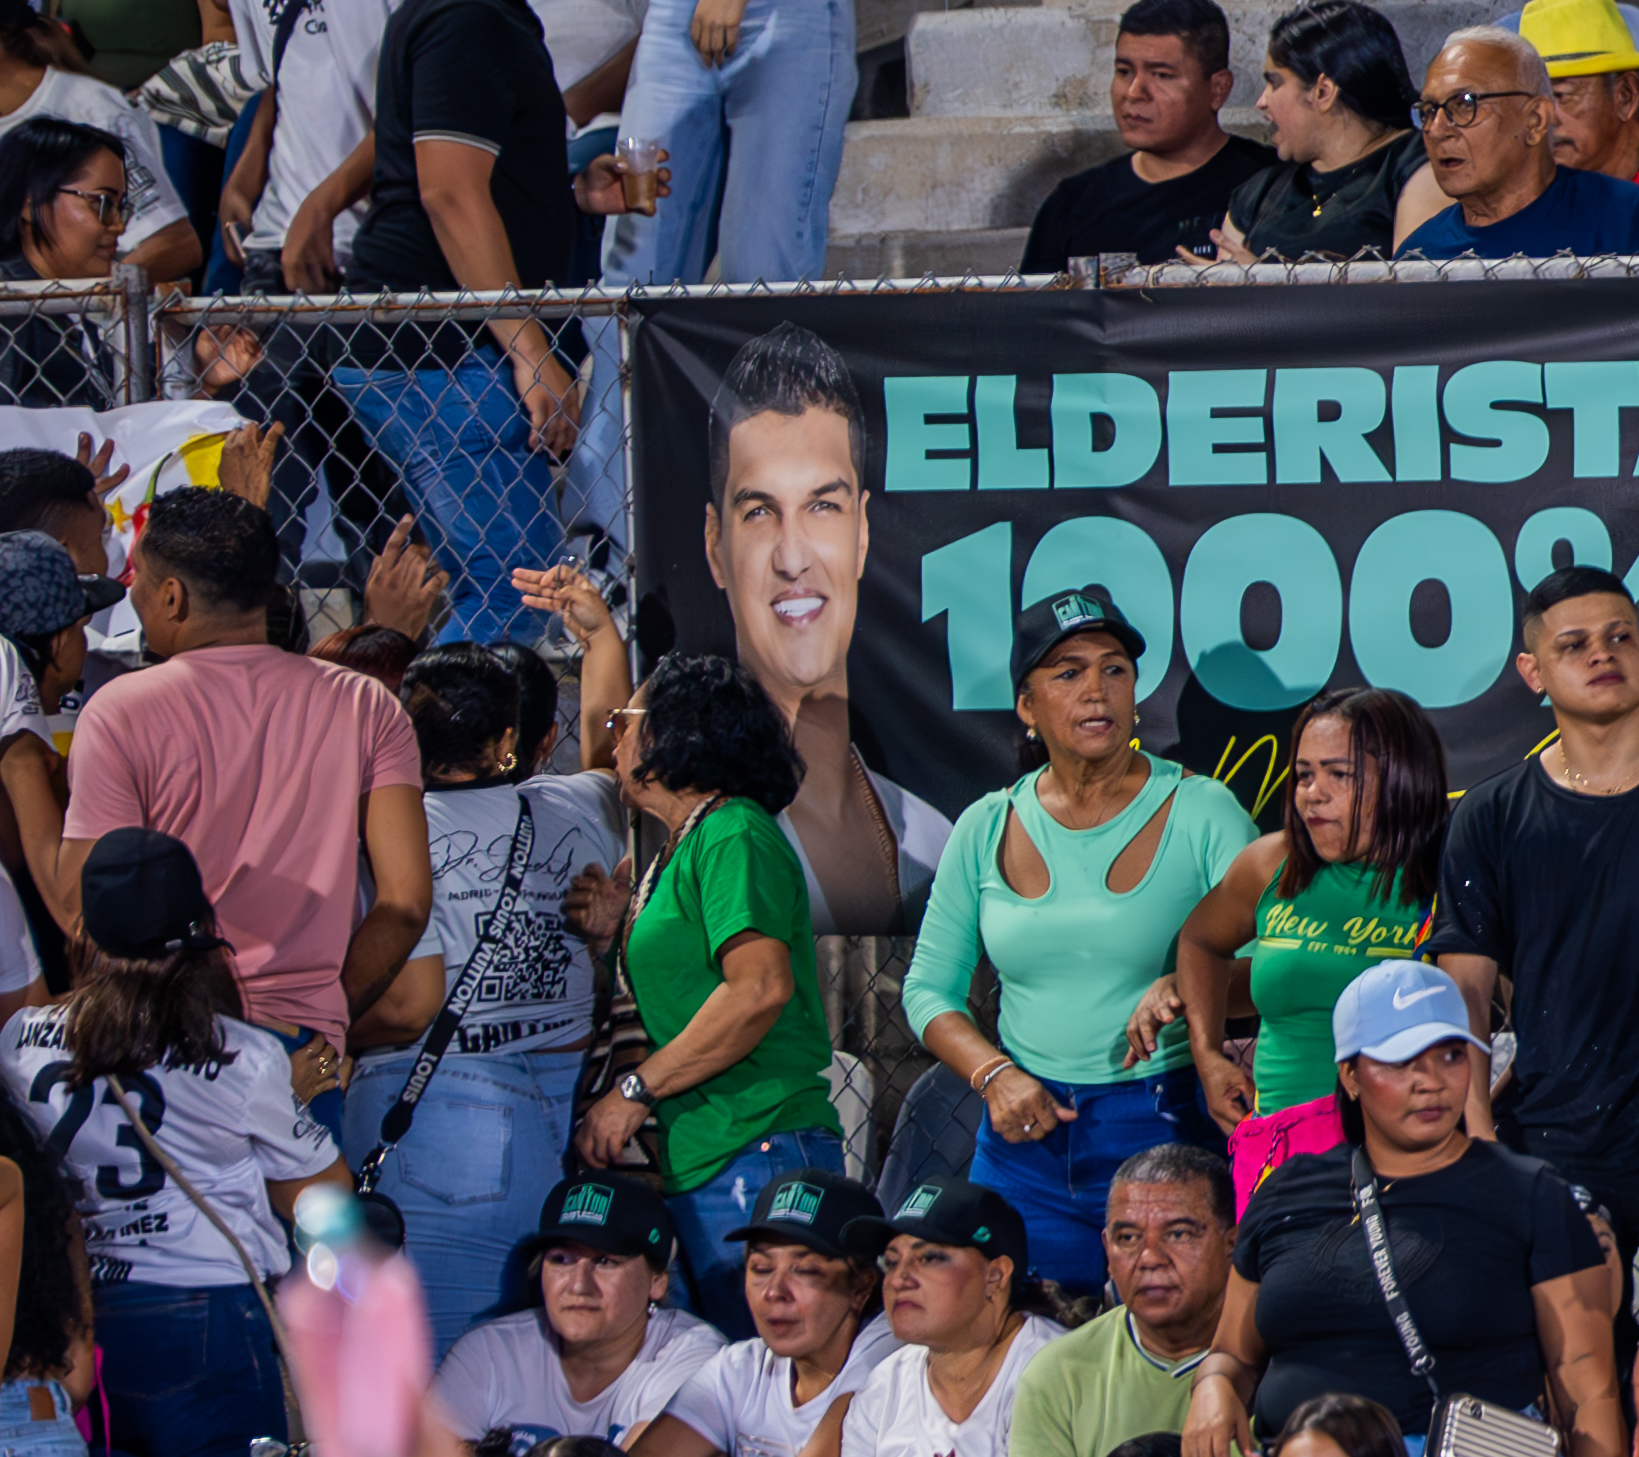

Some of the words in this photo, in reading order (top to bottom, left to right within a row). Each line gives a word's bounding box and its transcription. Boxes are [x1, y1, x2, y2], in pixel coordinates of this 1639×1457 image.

[488, 886, 518, 940] LOUIS
[1264, 903, 1329, 941] New
[1341, 916, 1421, 945] York
[446, 940, 497, 1017] VUITTON
[402, 1051, 439, 1105] LOUIS
[29, 1060, 167, 1200] 23
[1395, 1311, 1423, 1358] YOUNG
